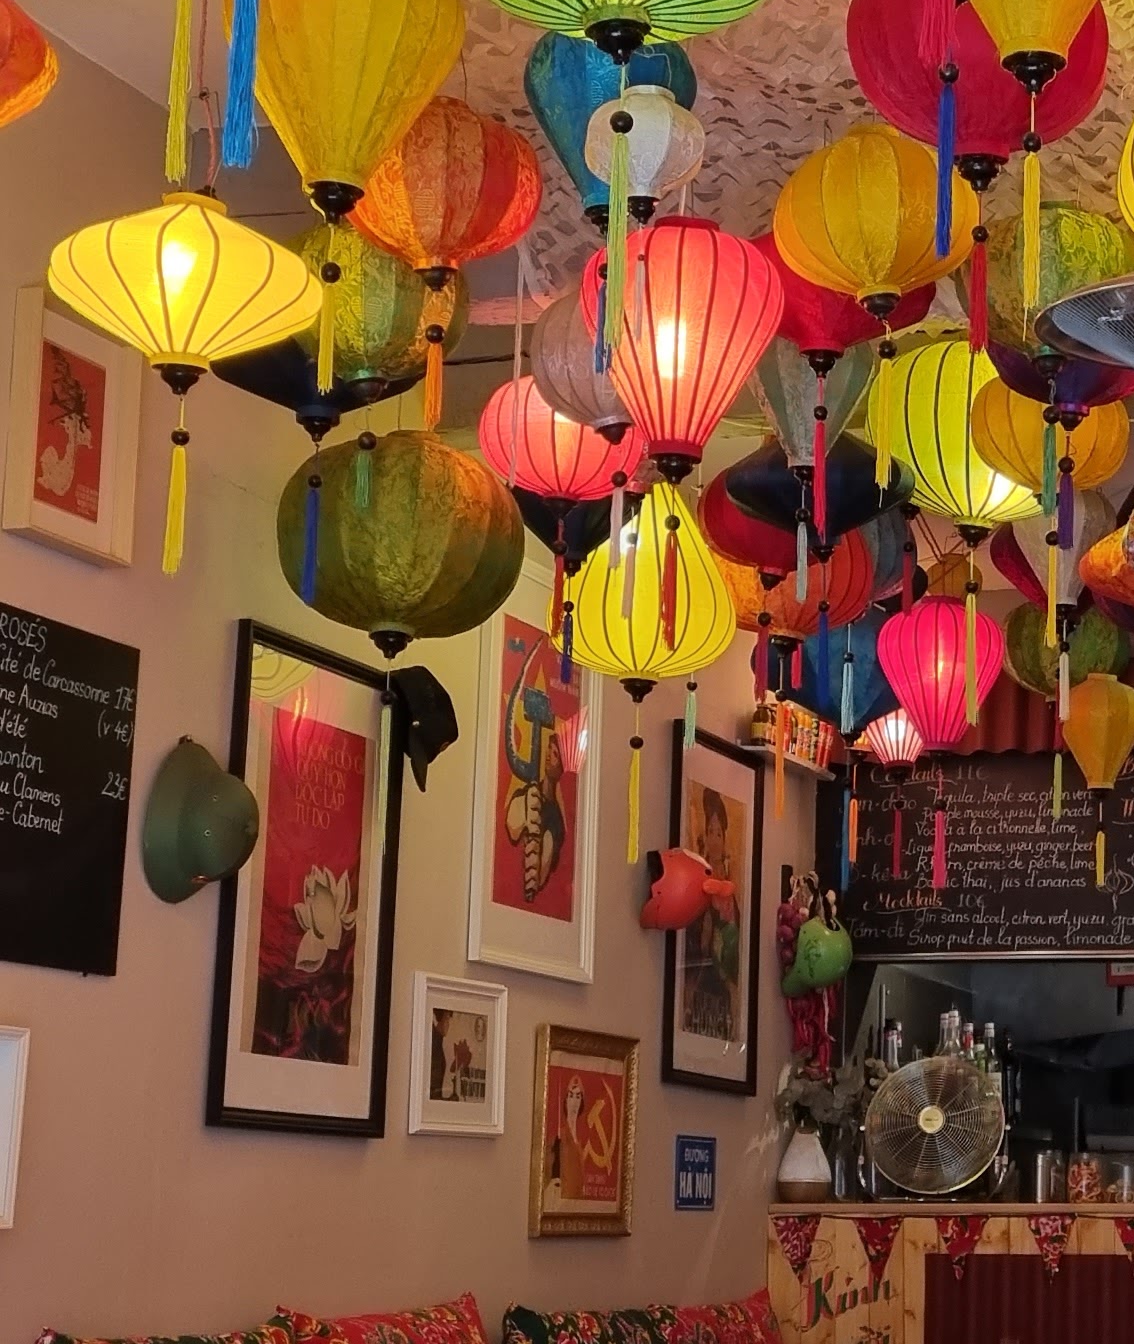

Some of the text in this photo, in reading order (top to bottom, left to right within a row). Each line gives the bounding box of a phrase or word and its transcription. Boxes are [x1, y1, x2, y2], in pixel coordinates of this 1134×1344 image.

[0, 642, 22, 674] ité
[23, 654, 41, 681] de
[42, 658, 110, 705] Carcassonne
[13, 771, 61, 807] Clamens
[982, 783, 1016, 809] triple
[1038, 800, 1094, 818] limnade
[1008, 851, 1025, 870] de
[999, 874, 1021, 893] jus
[940, 913, 970, 925] sans
